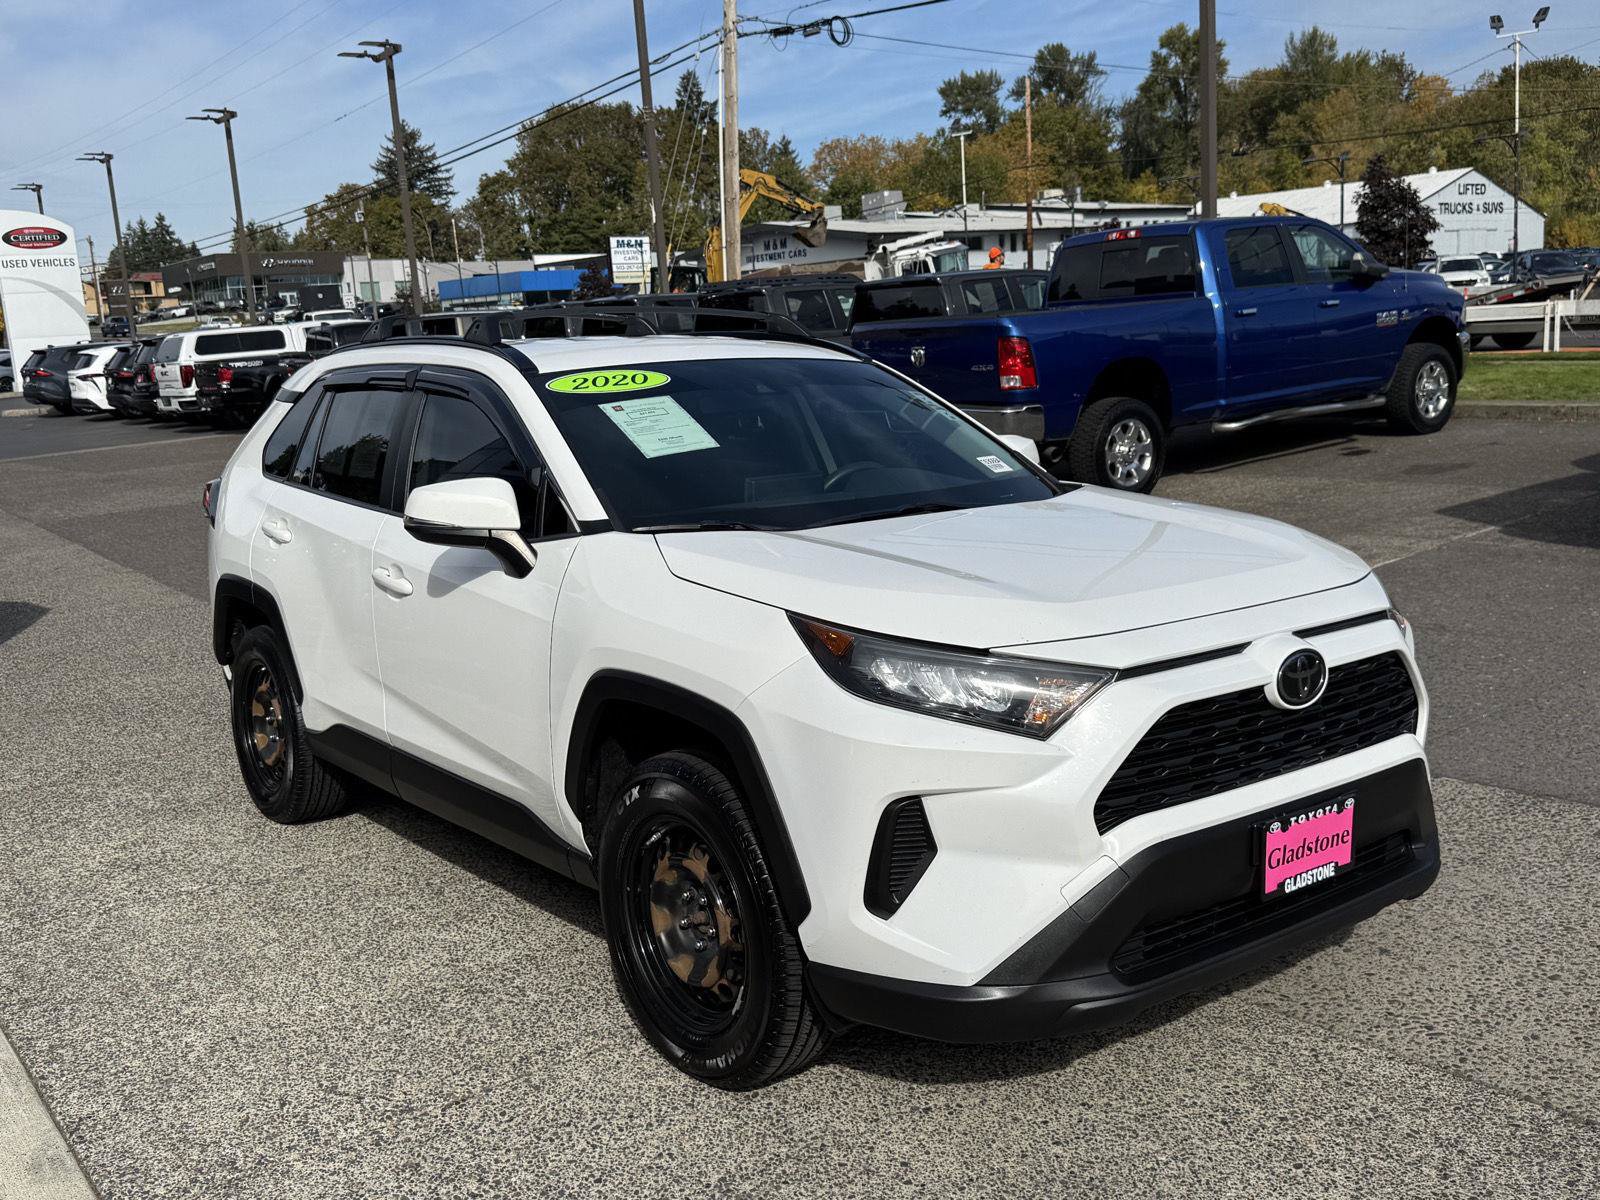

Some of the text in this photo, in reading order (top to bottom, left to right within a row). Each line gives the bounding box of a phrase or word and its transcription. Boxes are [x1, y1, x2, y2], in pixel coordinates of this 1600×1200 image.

[1458, 183, 1487, 196] LIFTED
[1438, 201, 1504, 215] TRUCKS & SUVS
[10, 233, 61, 242] CERTIFIED
[788, 248, 807, 259] CARS
[1, 257, 76, 269] USED VEHICLES
[571, 372, 649, 391] 2020
[1289, 803, 1338, 826] TOYOTA
[1267, 829, 1350, 870] Gladstone
[1284, 862, 1336, 893] GLADSTONE
